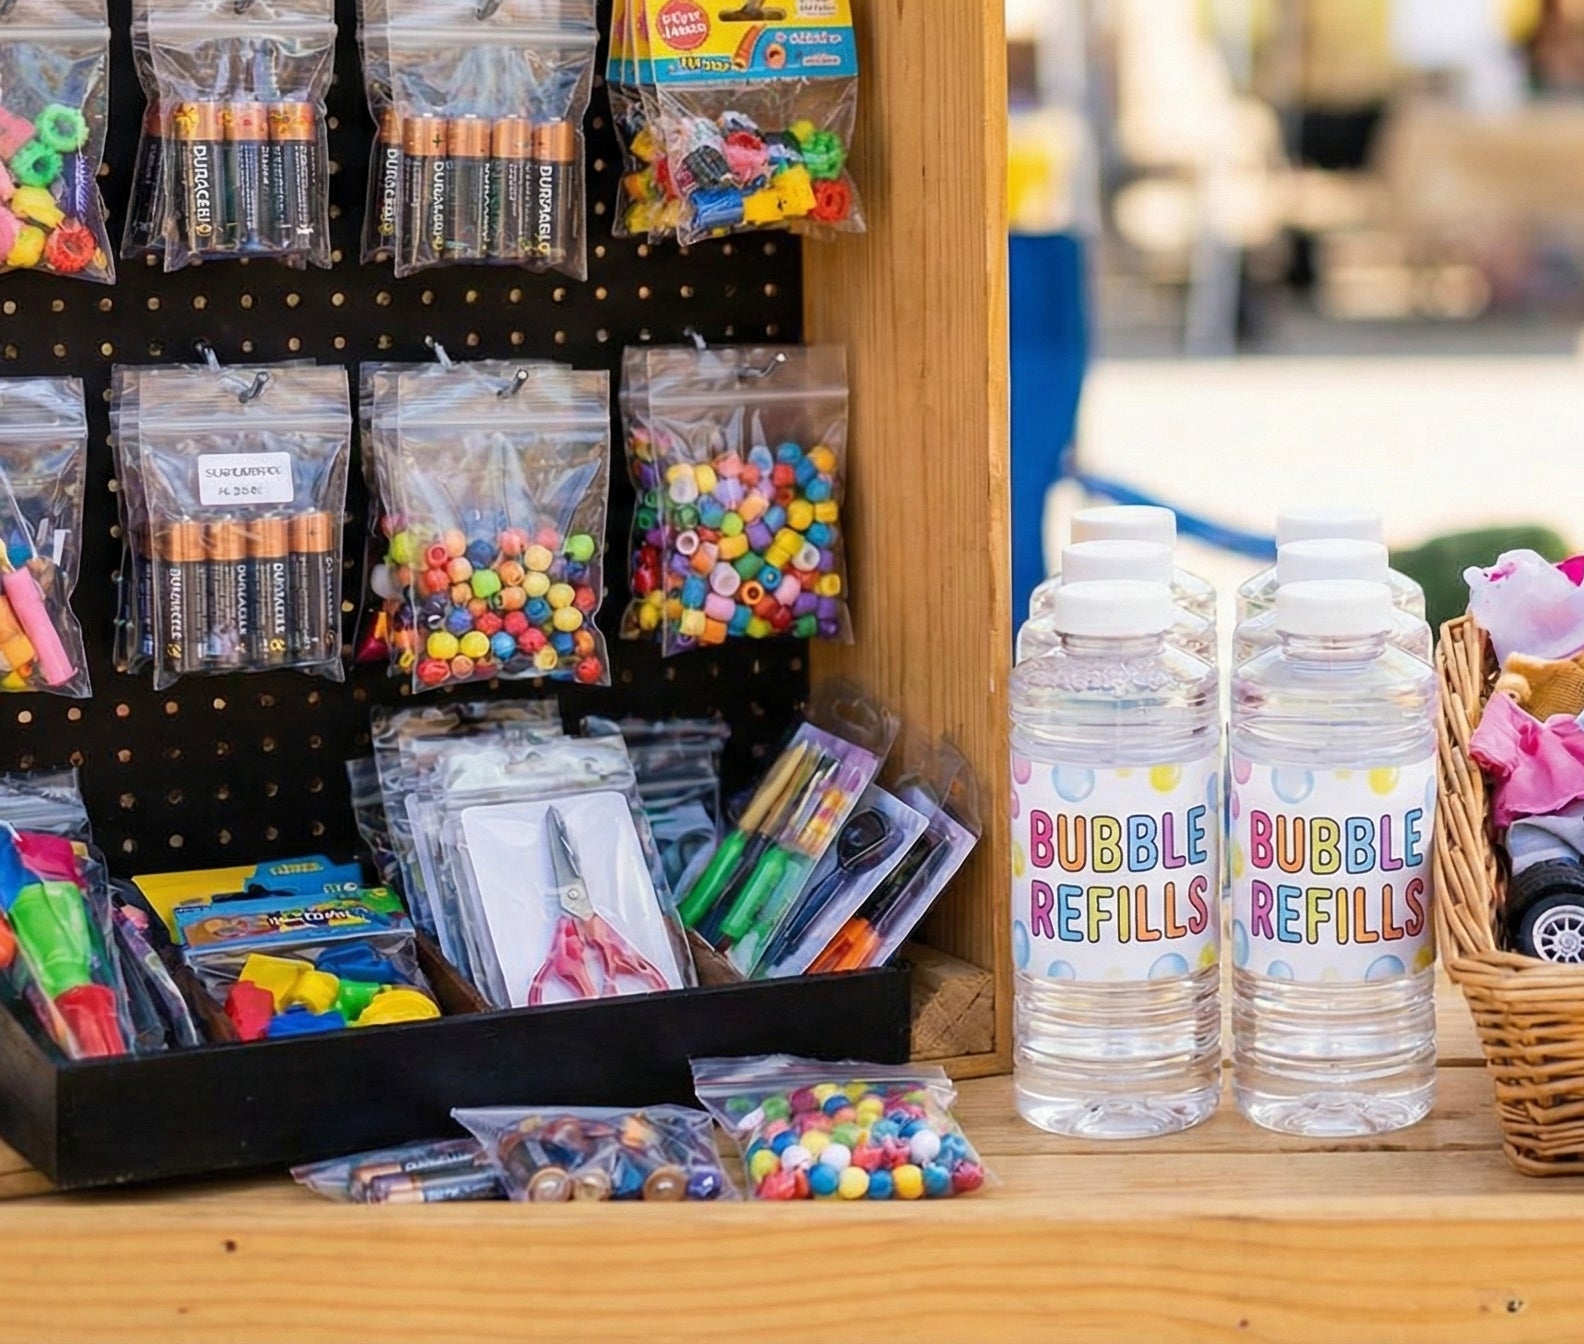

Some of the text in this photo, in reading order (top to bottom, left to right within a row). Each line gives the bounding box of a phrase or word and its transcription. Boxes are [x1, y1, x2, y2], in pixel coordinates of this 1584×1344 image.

[1030, 804, 1208, 874] BUBBLE
[1250, 807, 1424, 875] BUBBLE
[1031, 875, 1209, 944] REFILLS
[1251, 878, 1425, 945] REFILLS
